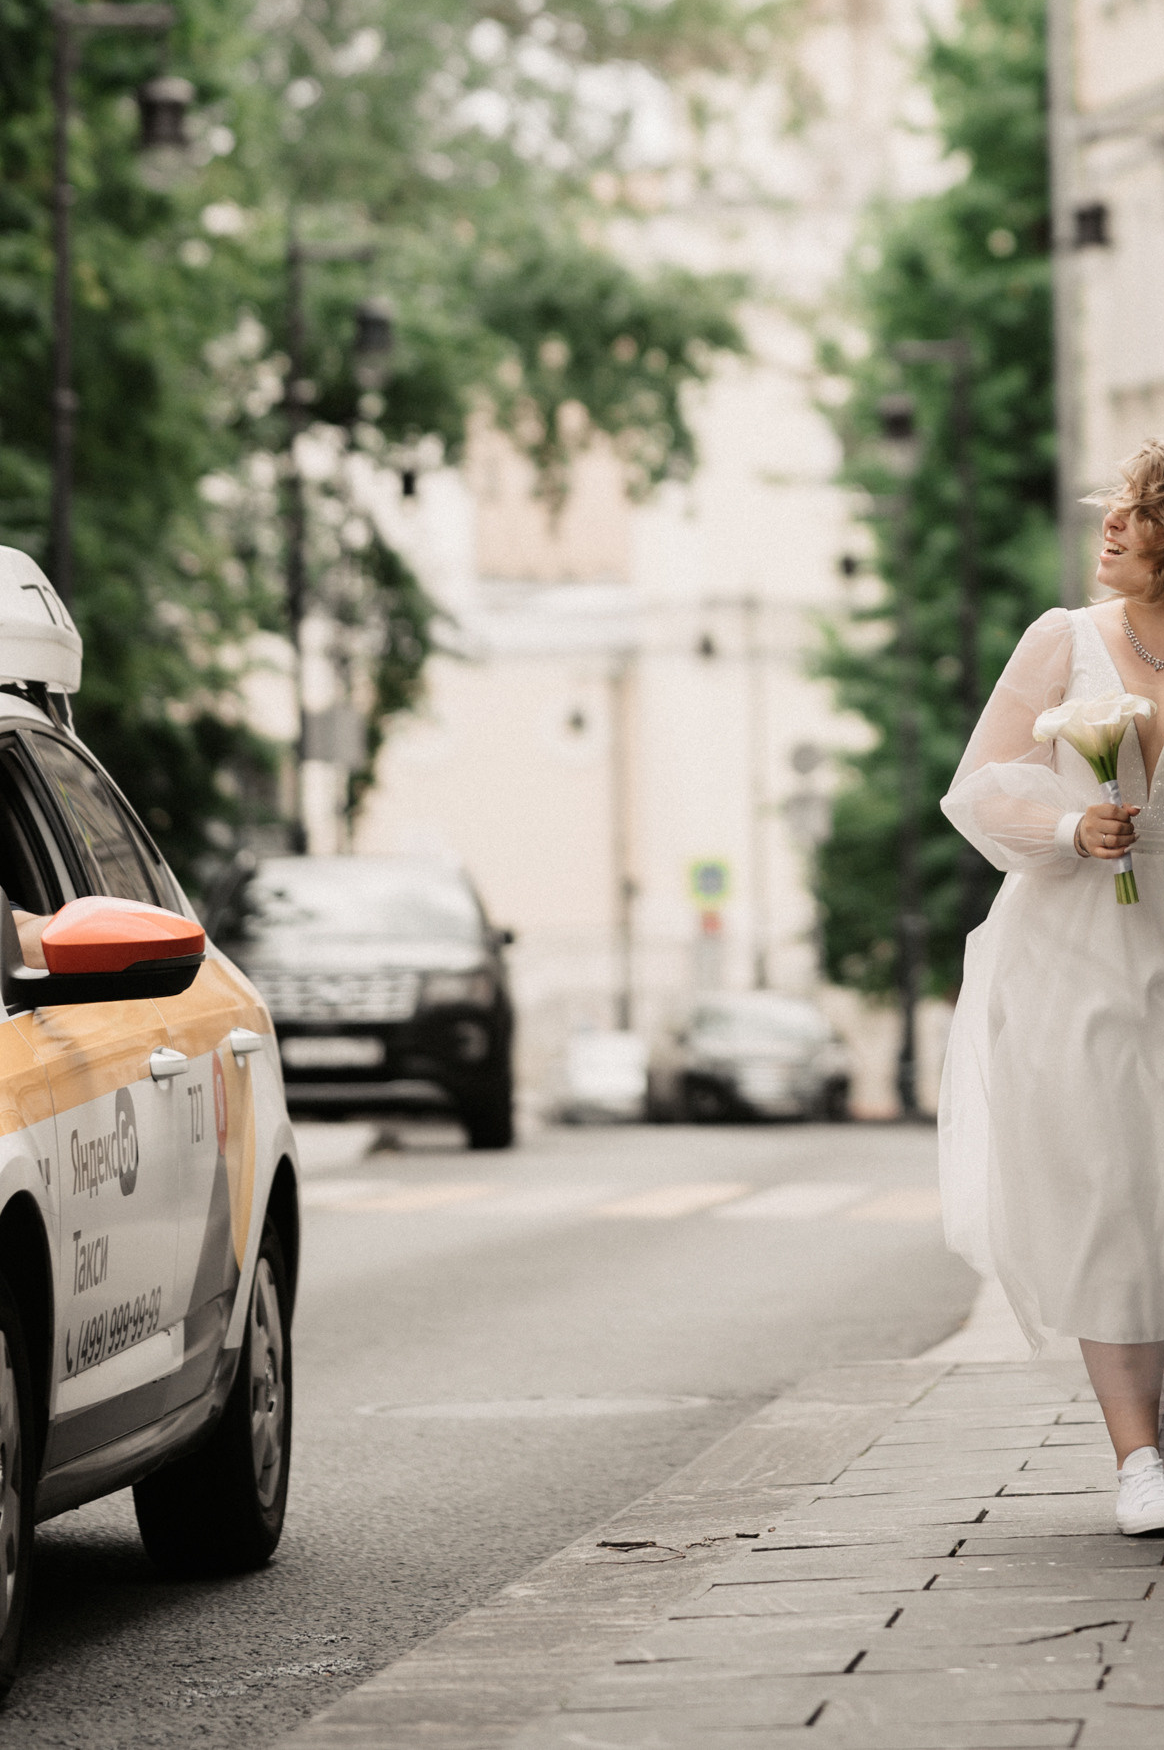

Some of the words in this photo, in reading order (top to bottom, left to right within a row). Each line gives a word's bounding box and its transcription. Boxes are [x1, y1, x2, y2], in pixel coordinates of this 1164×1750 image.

[187, 1083, 204, 1144] 727
[71, 1129, 118, 1199] Яндекс
[119, 1110, 137, 1174] Go
[73, 1229, 109, 1296] Такси
[75, 1310, 108, 1374] (499)
[108, 1285, 161, 1354] 999-99-99
